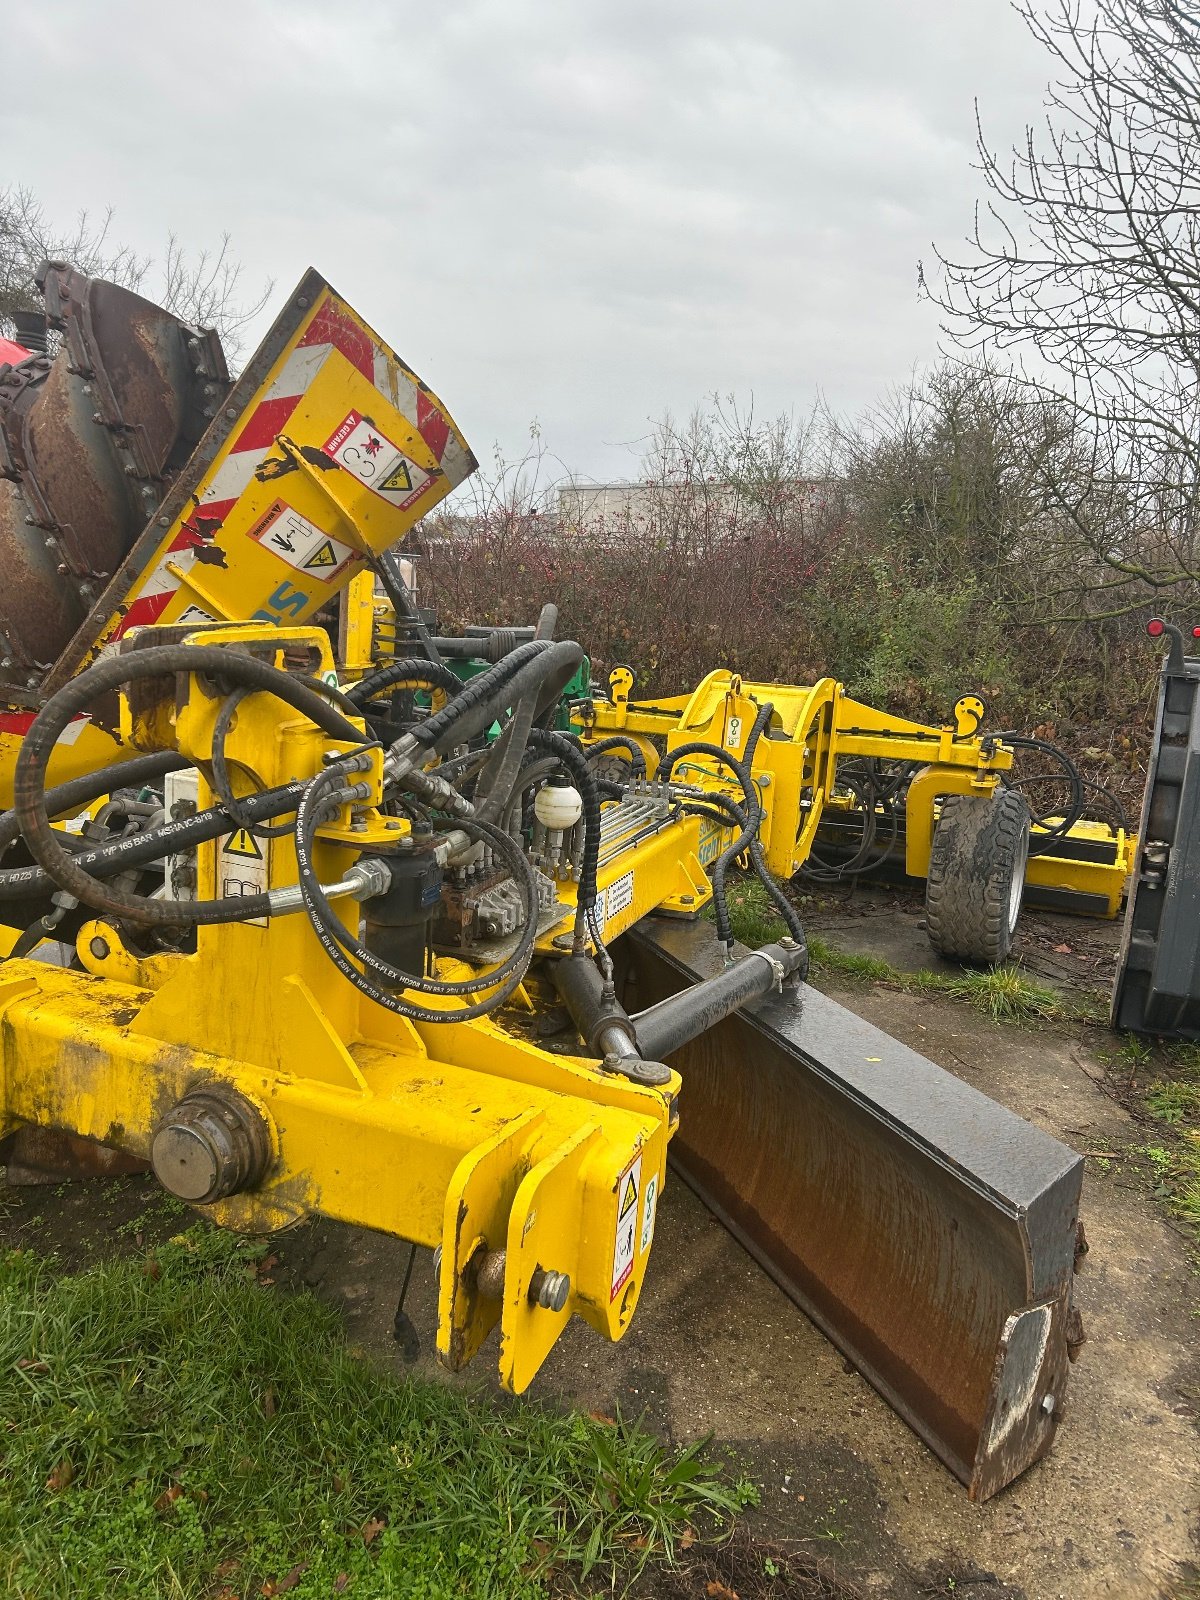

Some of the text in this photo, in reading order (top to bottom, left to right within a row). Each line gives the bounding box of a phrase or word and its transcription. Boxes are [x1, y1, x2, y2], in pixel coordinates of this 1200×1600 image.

[328, 426, 350, 452] GEFAHR
[402, 486, 426, 507] DANGER
[253, 512, 276, 536] WARNUNG
[86, 852, 96, 863] 25
[102, 844, 117, 858] WP
[310, 910, 324, 934] HD208
[322, 935, 332, 947] EN
[338, 960, 352, 973] 2SN
[356, 978, 368, 990] WP
[366, 986, 380, 998] 350
[381, 996, 396, 1010] BAR
[355, 948, 398, 979] HANSA-FLEX
[399, 976, 421, 988] HD208
